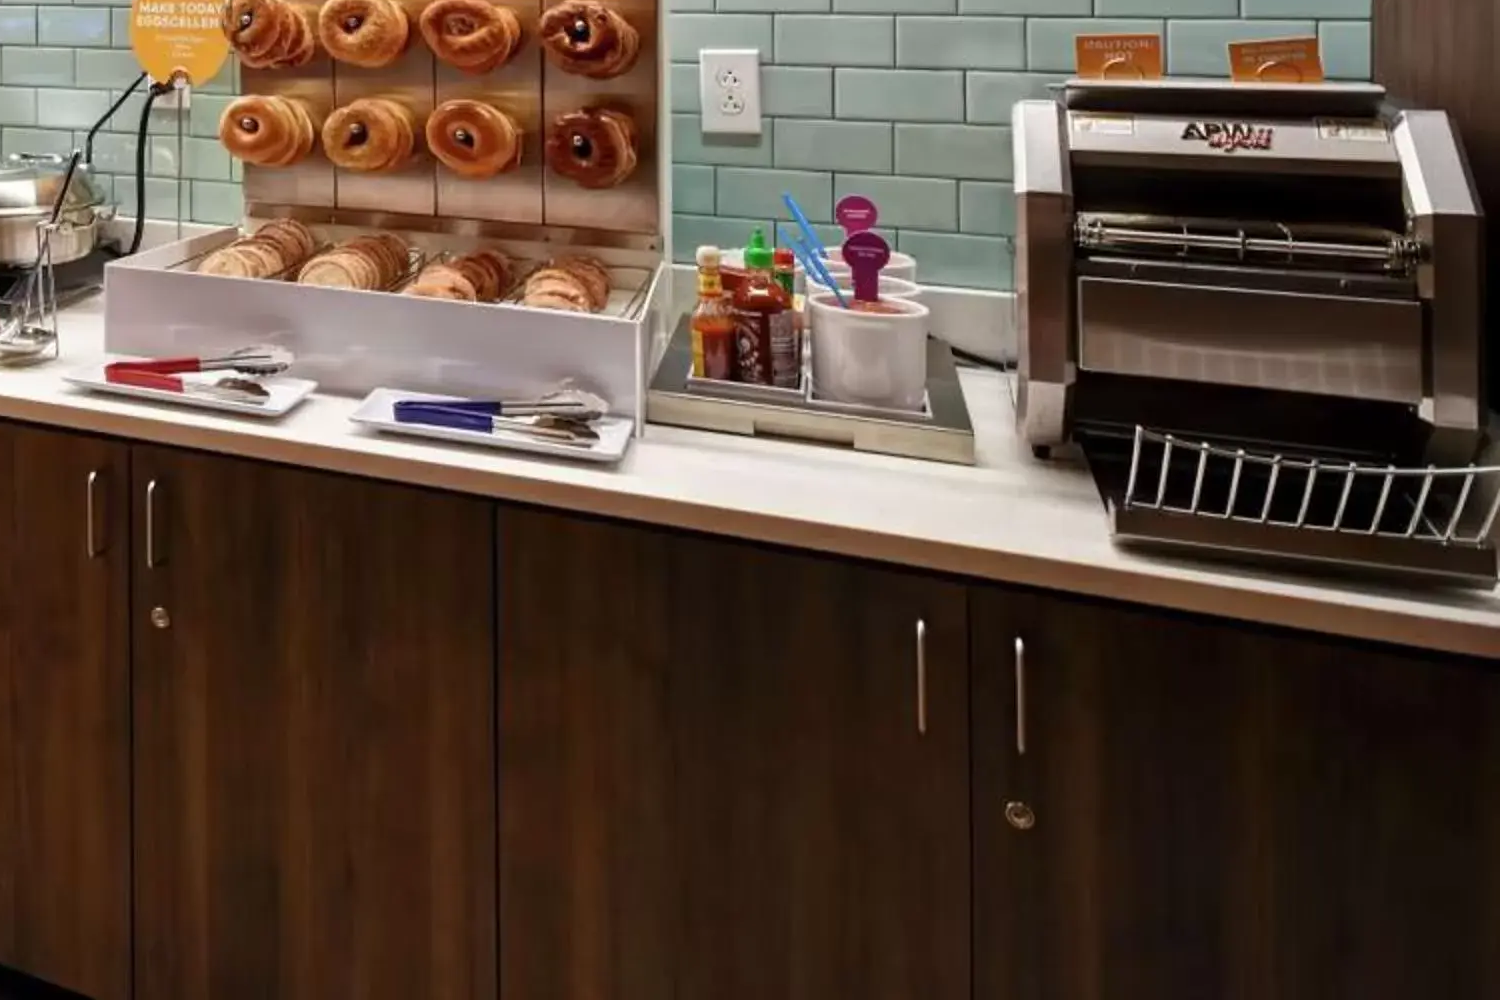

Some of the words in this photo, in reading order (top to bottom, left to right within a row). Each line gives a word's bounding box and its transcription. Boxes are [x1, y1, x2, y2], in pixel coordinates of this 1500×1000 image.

[139, 1, 175, 14] MAKE
[179, 1, 223, 15] TODAY
[137, 15, 222, 29] EGGSCELLEN
